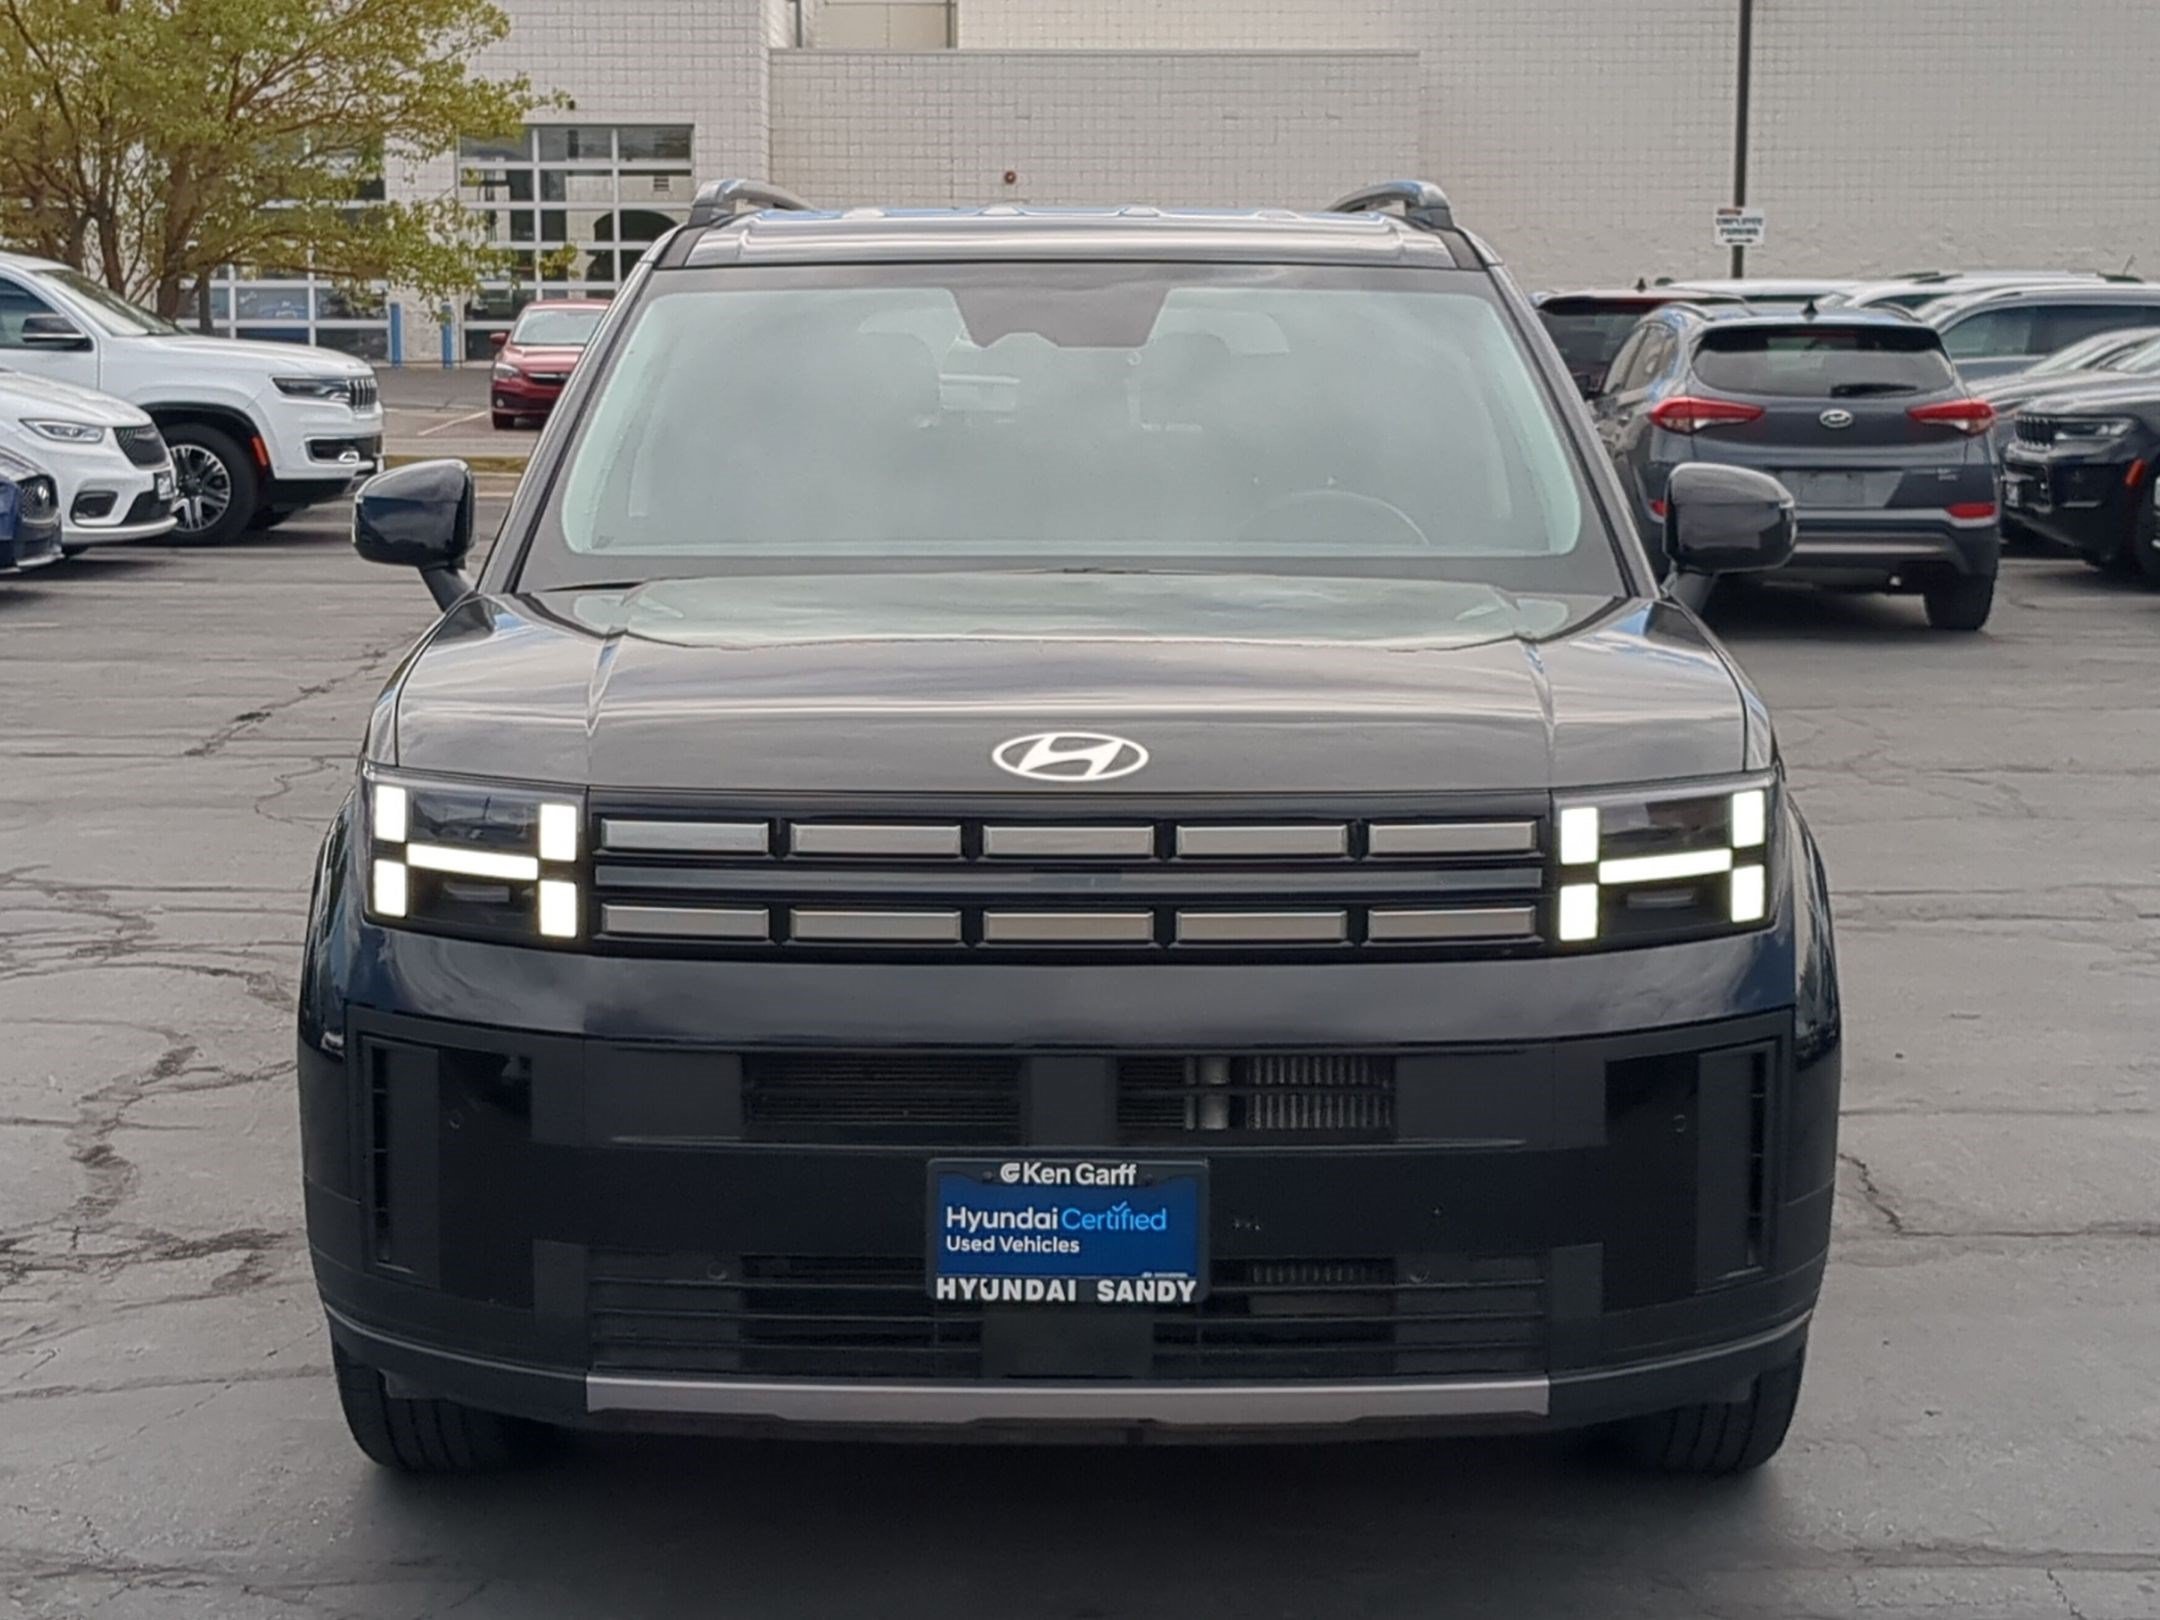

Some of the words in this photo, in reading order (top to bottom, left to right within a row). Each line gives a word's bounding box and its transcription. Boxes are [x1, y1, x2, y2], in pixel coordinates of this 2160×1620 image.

[1023, 1162, 1071, 1184] Ken
[1075, 1163, 1137, 1186] Garff
[946, 1206, 1059, 1233] Hyundai
[1061, 1202, 1167, 1231] Certified
[946, 1235, 995, 1252] Used
[999, 1235, 1080, 1253] Vehicles
[936, 1278, 1077, 1301] HYUNDAI
[1097, 1279, 1197, 1302] SANDY
